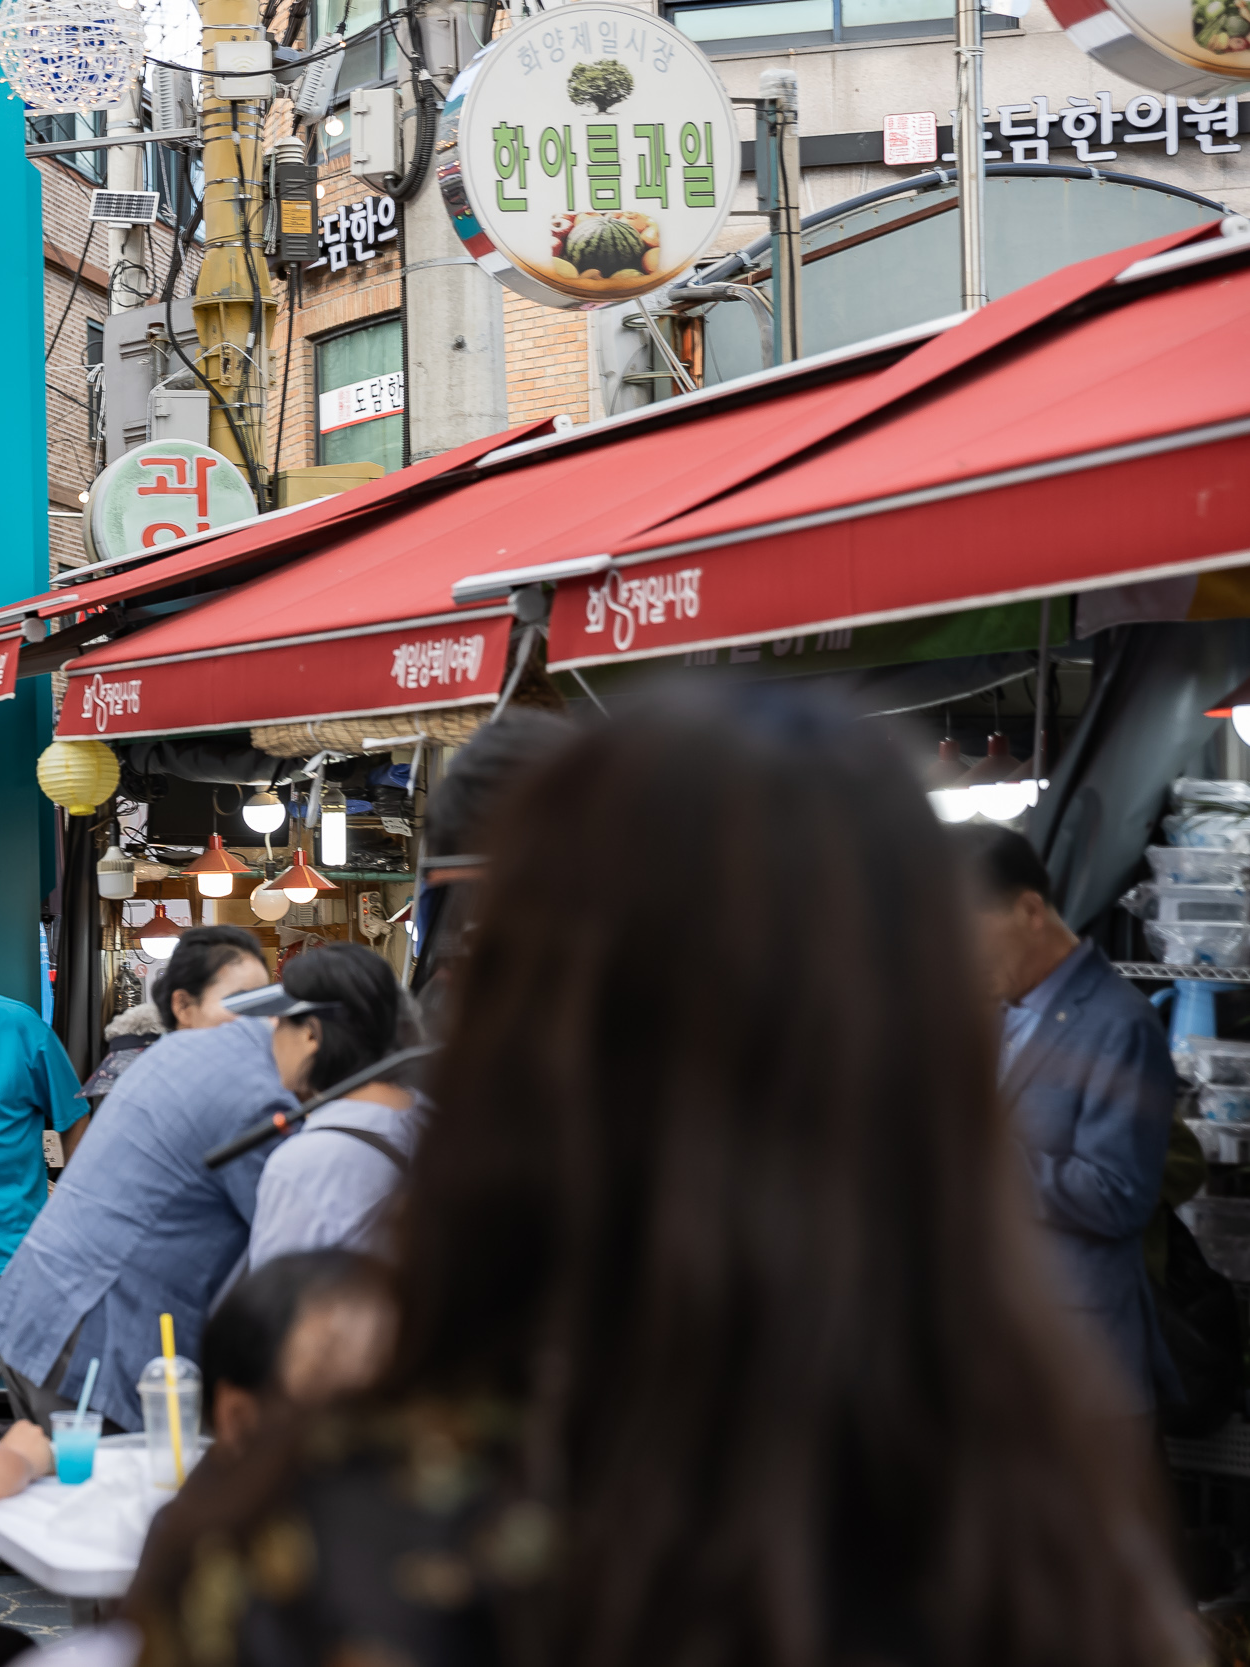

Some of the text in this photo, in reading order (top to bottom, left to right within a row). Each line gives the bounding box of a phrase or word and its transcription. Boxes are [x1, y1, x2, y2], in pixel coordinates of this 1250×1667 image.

[517, 21, 675, 76] 화양제일시장
[493, 121, 716, 213] 한아름과일
[354, 374, 404, 414] 도담한
[584, 568, 703, 651] 화양제일시장
